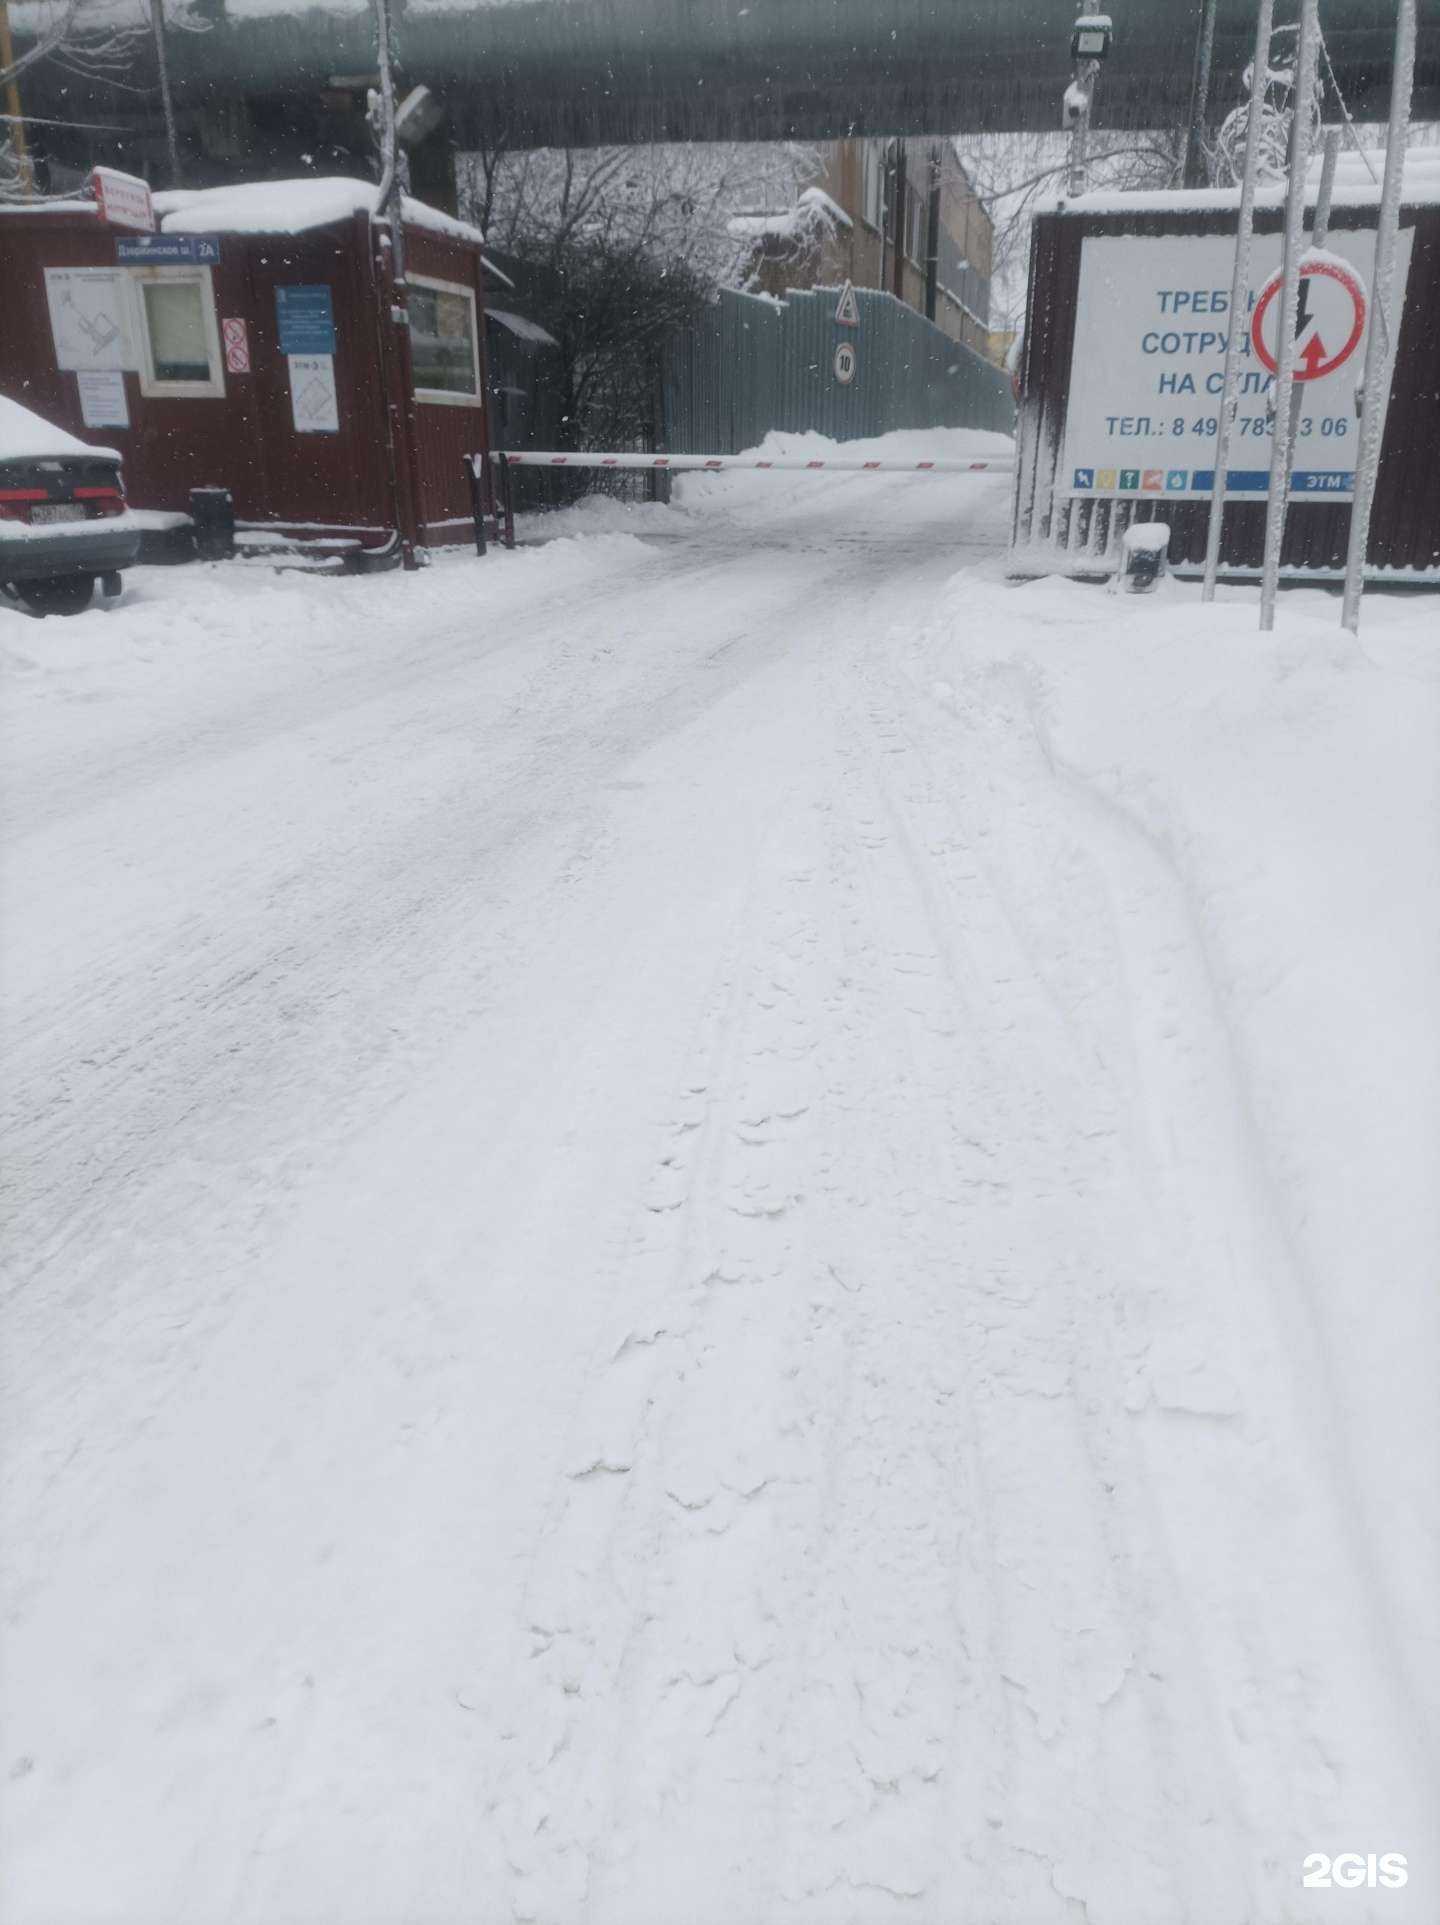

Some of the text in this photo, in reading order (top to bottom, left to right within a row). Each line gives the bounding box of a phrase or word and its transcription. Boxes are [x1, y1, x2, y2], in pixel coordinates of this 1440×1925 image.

[839, 355, 851, 372] 10
[1158, 372, 1196, 394] НА
[1105, 416, 1165, 436] ТЕЛ.:
[1172, 417, 1185, 436] 8
[1192, 417, 1218, 436] 49
[1320, 417, 1347, 436] 06
[1306, 475, 1342, 489] ЭТМ
